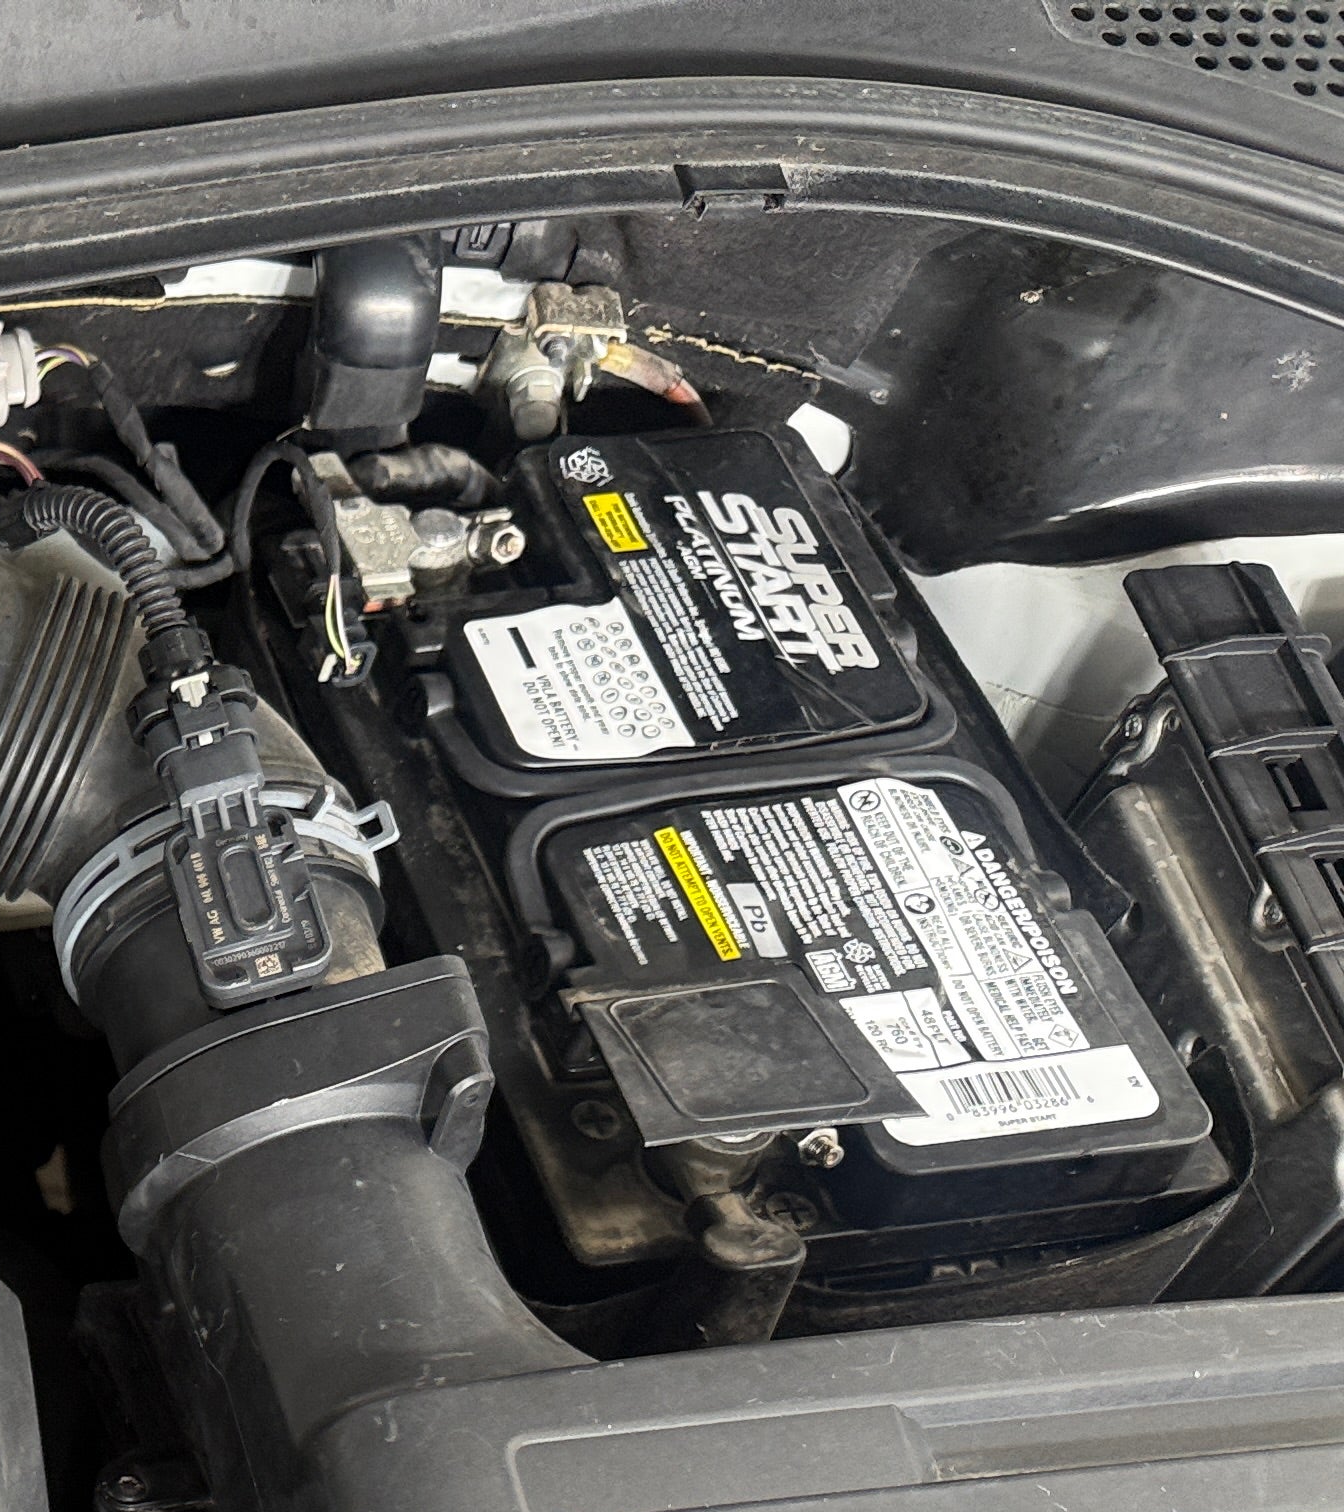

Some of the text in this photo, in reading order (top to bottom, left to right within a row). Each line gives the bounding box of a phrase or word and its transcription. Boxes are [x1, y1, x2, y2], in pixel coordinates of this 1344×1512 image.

[661, 495, 766, 640] PLATINUM
[675, 546, 708, 580] AGM
[695, 491, 844, 671] START
[752, 506, 880, 671] SUPER
[521, 680, 539, 695] DO
[529, 696, 550, 715] NOT
[533, 674, 580, 742] VRLA BATTERY
[658, 831, 675, 843] DO
[664, 843, 684, 860] NOT
[673, 860, 702, 894] ATTEMPT
[692, 894, 708, 905] TO
[206, 909, 221, 925] AG
[698, 906, 720, 927] OPEN
[740, 903, 772, 934] Pb
[971, 847, 1081, 995] DANGER/POISON
[211, 927, 226, 945] VW
[808, 953, 851, 988] AGM
[950, 978, 966, 990] DO
[955, 990, 975, 1005] NOT
[983, 981, 1012, 1013] MEDICAL
[964, 1006, 987, 1025] OPEN
[862, 1019, 884, 1037] 120
[884, 1022, 910, 1045] 760
[916, 1009, 952, 1046] 48PLT
[972, 1102, 1018, 1118] 83996
[1024, 1097, 1069, 1111] 03286
[998, 1113, 1057, 1128] SUPER START
